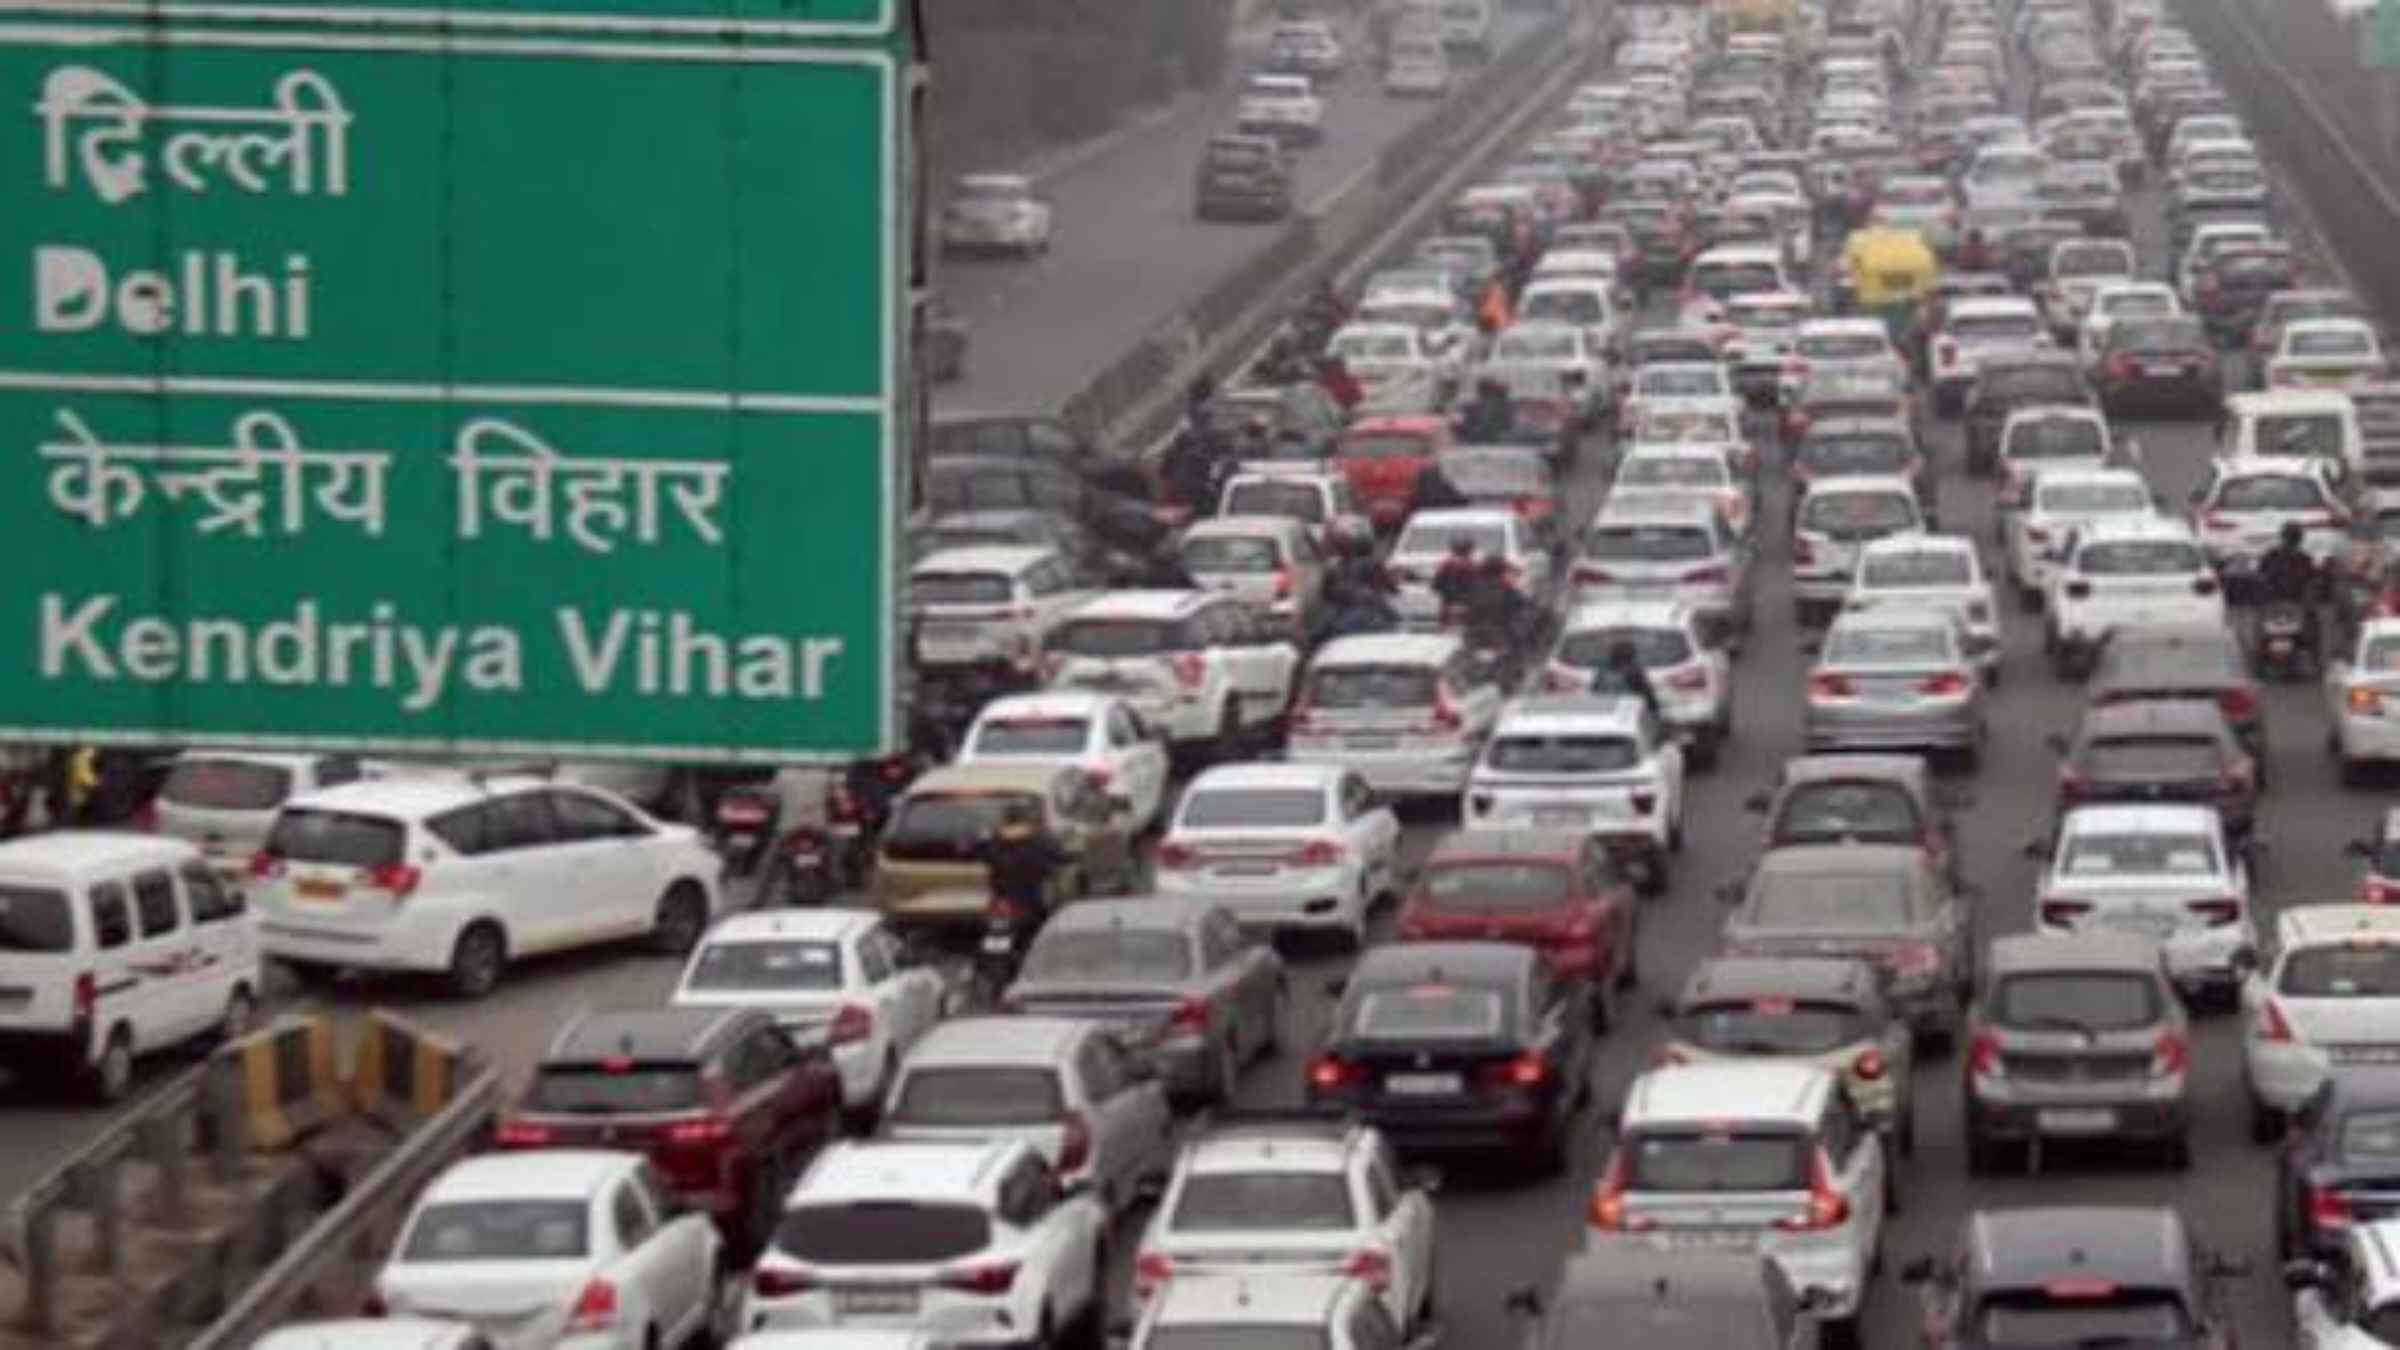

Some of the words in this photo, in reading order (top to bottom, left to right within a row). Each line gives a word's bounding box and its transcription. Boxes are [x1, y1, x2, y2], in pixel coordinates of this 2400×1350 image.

[35, 67, 352, 202] दिल्ली
[35, 247, 308, 336] Delhi
[40, 411, 390, 535] केन्द्रीय
[448, 419, 730, 551] विहार
[41, 596, 522, 709] Kendriya
[559, 609, 843, 698] Vihar
